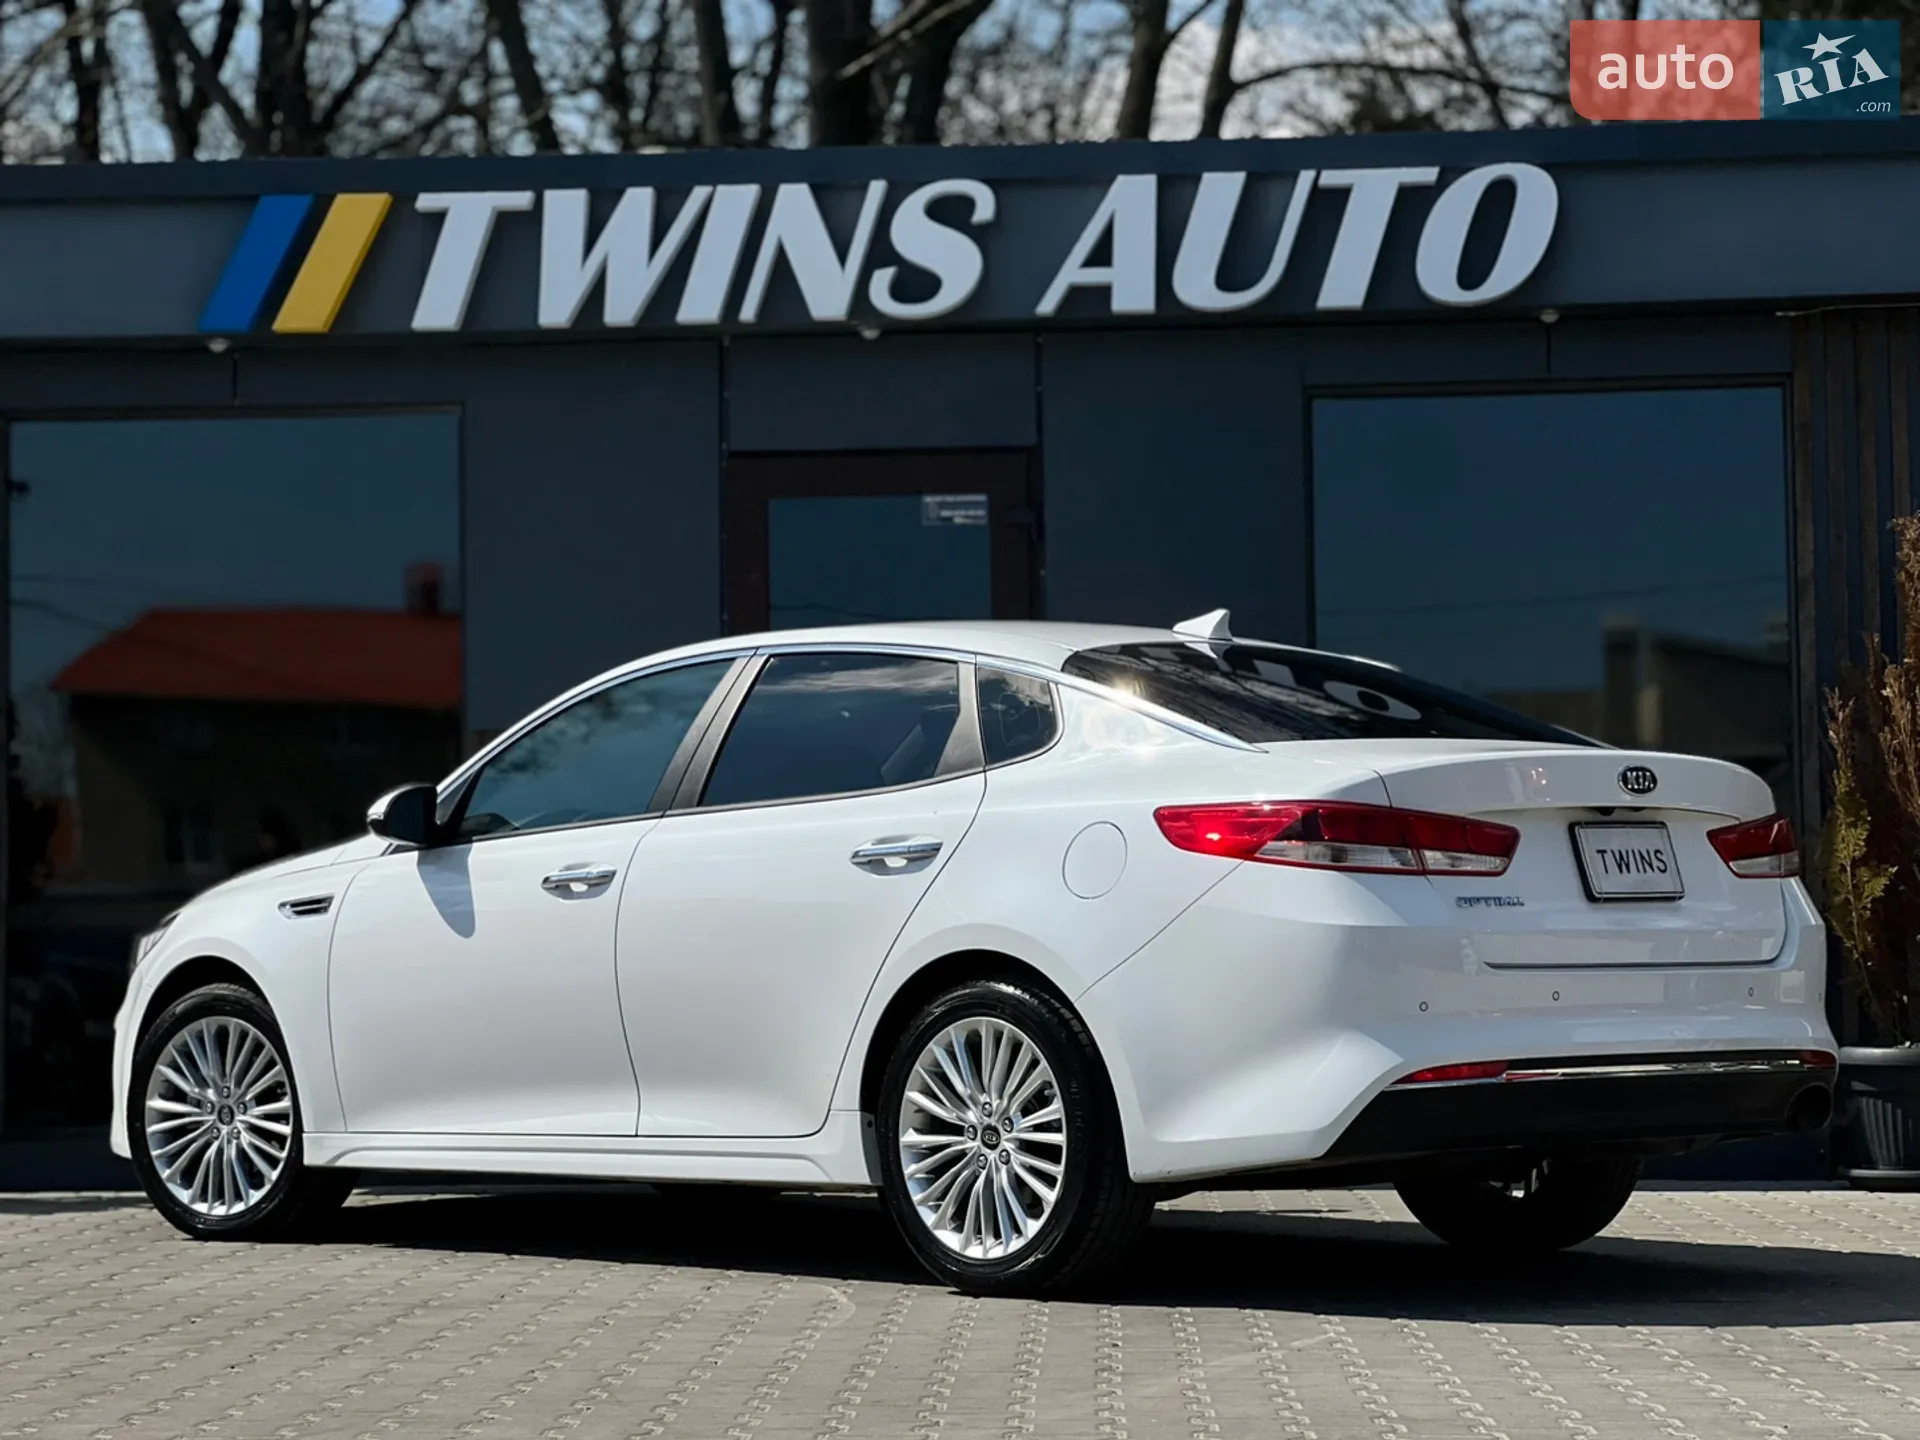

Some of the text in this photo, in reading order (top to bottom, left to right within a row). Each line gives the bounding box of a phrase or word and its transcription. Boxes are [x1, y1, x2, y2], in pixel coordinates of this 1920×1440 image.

[411, 162, 1559, 331] TWINS AUTO
[1626, 771, 1654, 789] KIA
[1596, 849, 1668, 875] TWINS
